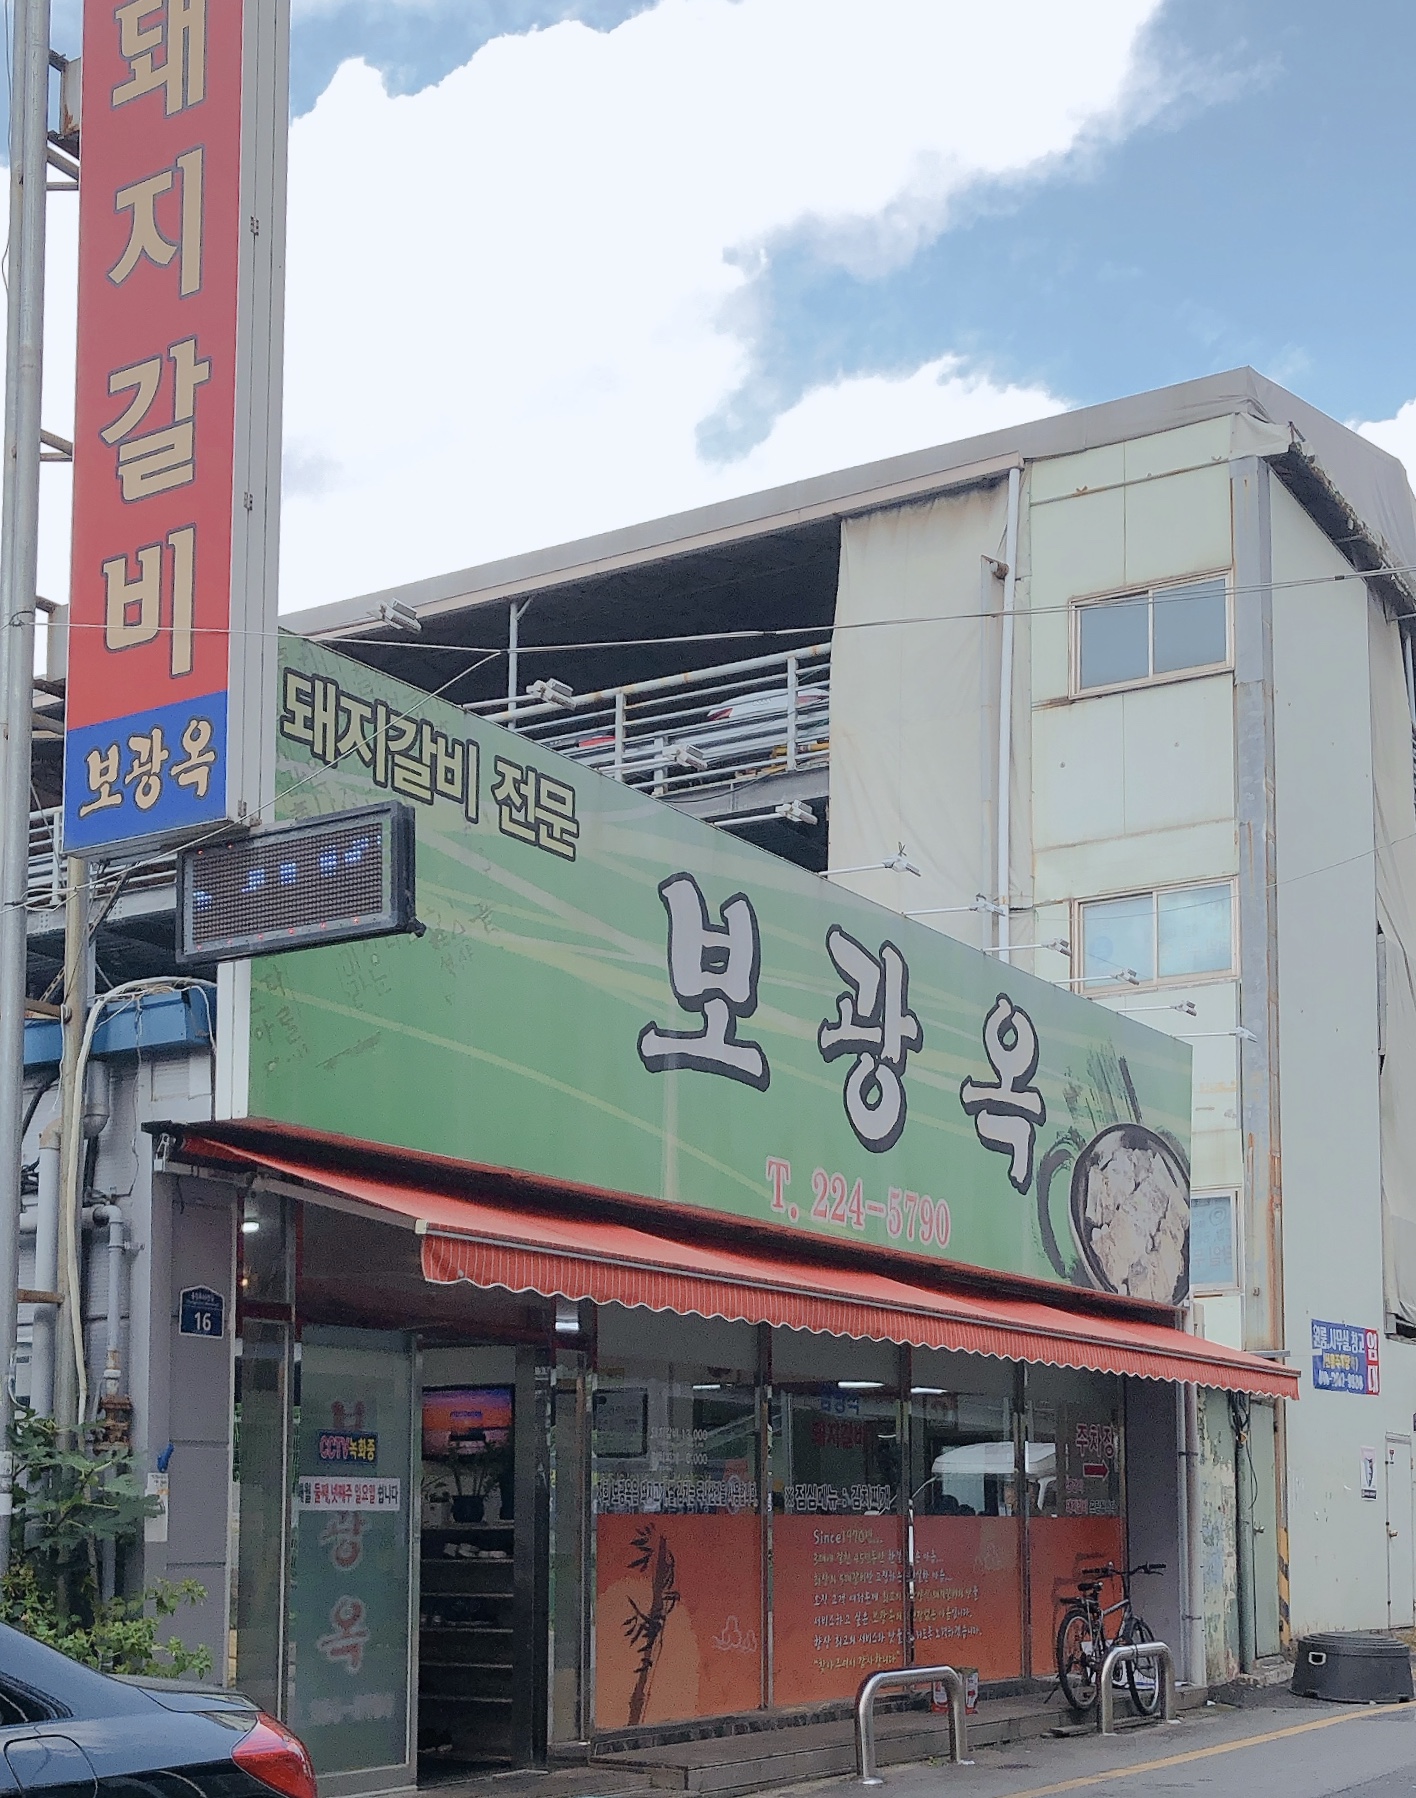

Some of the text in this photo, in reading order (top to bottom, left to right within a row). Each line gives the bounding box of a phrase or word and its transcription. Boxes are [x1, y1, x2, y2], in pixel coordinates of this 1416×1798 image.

[101, 0, 212, 679] 돼지갈비
[77, 716, 217, 819] 보광옥
[281, 667, 580, 862] 돼지갈비 전문
[637, 871, 1047, 1195] 보광옥
[766, 1155, 951, 1249] T. 224-5790
[194, 1312, 212, 1332] 16
[1366, 1331, 1379, 1393] 임대
[1076, 1423, 1115, 1459] 주차장
[354, 1484, 376, 1505] 일요일
[378, 1485, 398, 1505] 쉽니다
[831, 1591, 846, 1605] 고객
